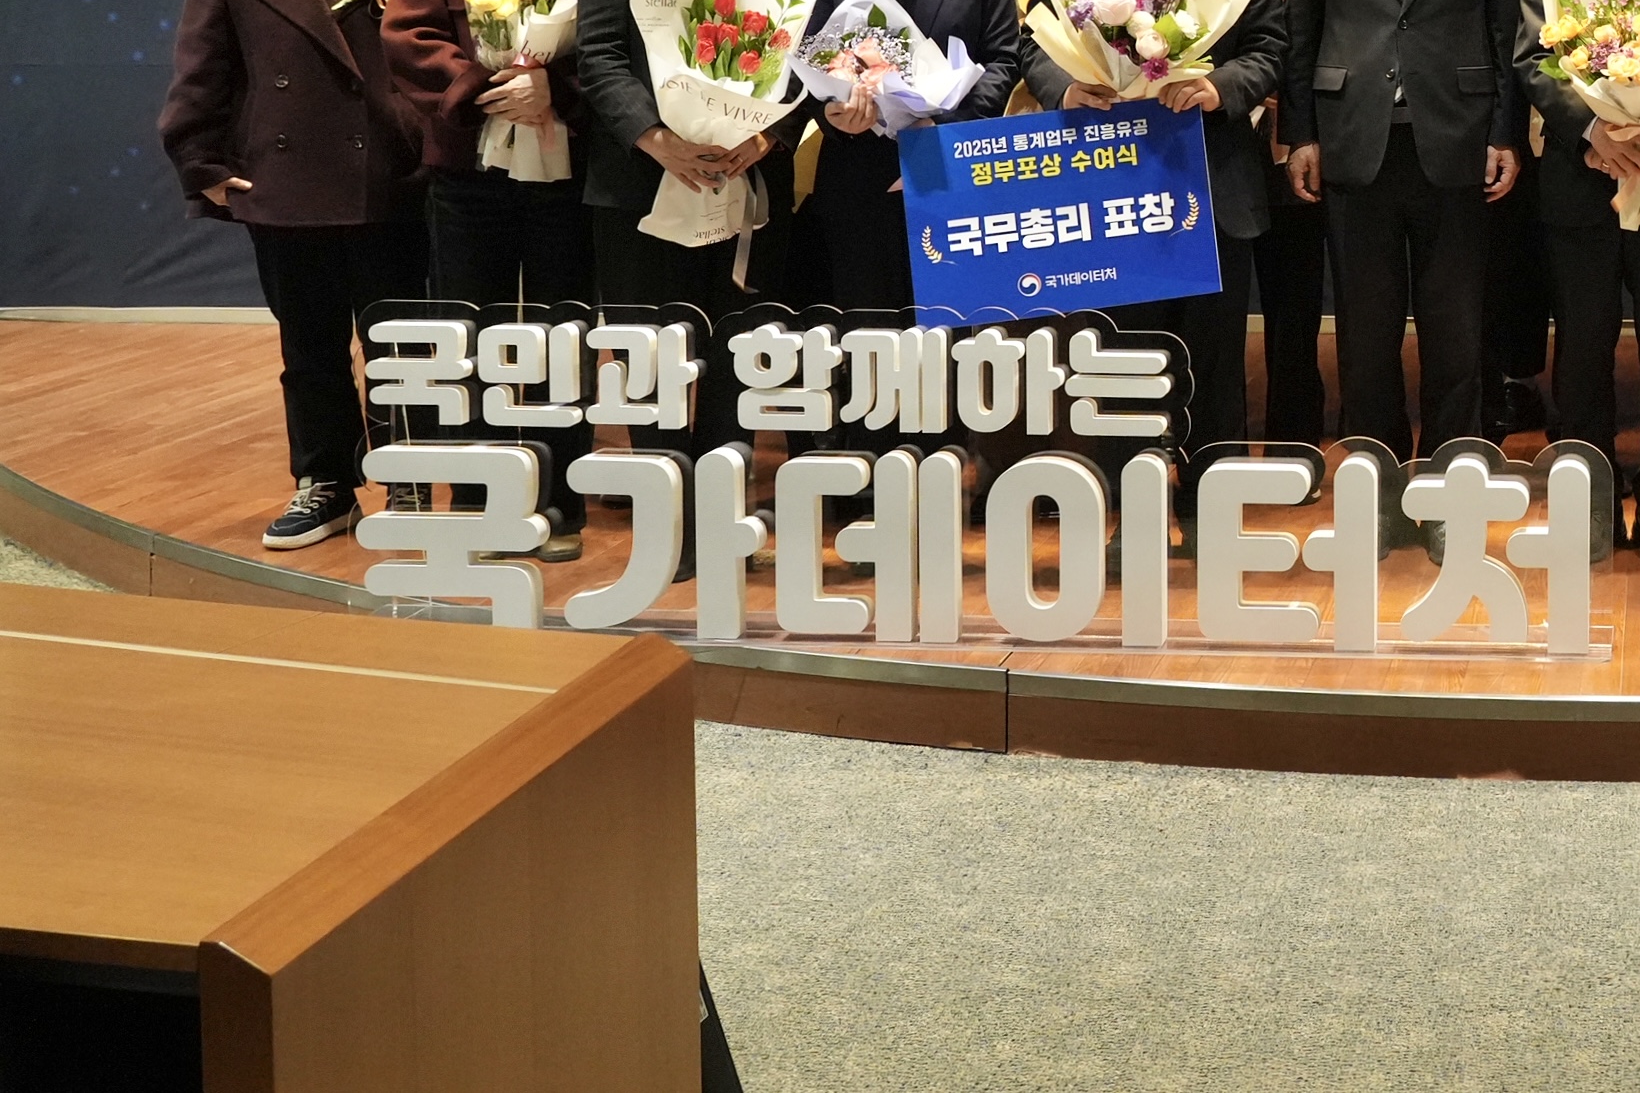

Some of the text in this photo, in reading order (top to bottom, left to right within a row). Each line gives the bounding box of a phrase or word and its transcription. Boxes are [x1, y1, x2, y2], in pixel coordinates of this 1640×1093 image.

[723, 102, 774, 125] VIVRE
[953, 118, 1149, 159] 2025년 통계업무 진흥유공
[970, 143, 1138, 187] 정부포상 수여식
[946, 191, 1175, 257] 국무총리 표창
[1044, 267, 1118, 289] 국가데이터처
[365, 319, 1176, 438] 국민과 함께하는
[355, 439, 1592, 656] 국가데이터처
